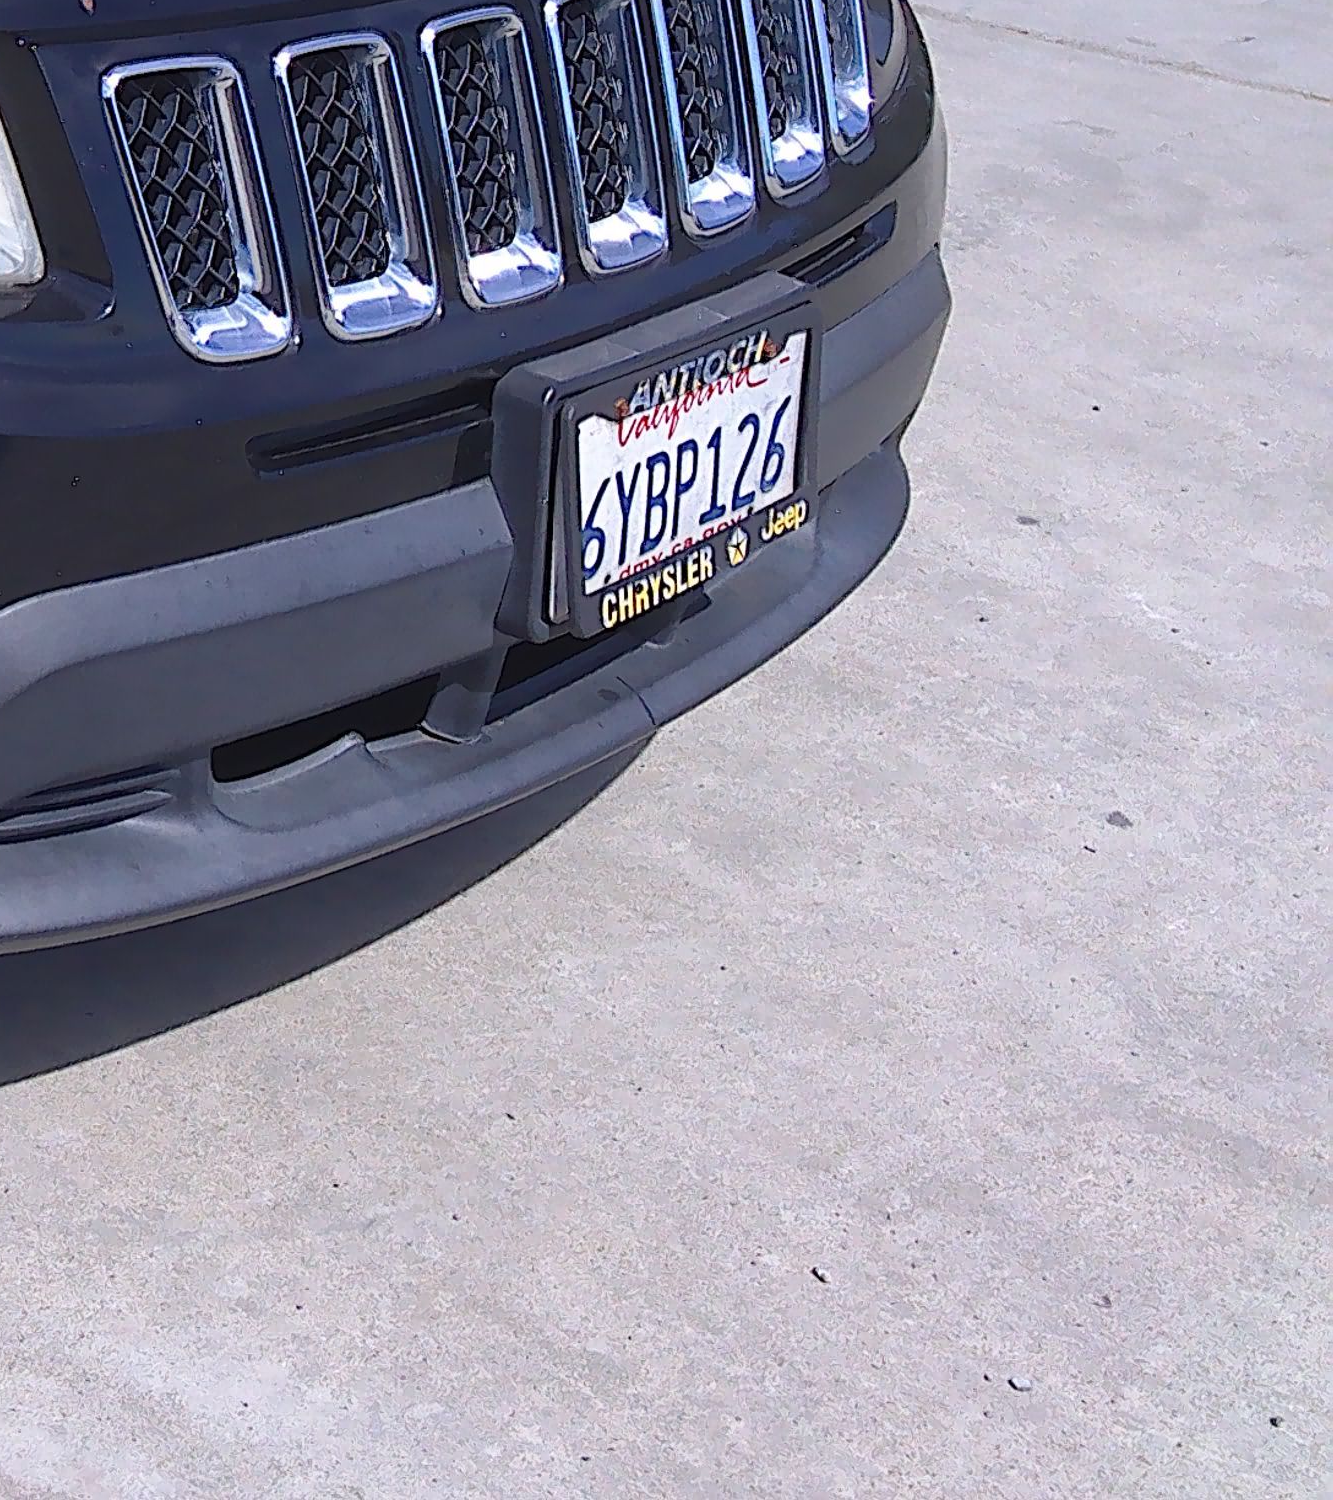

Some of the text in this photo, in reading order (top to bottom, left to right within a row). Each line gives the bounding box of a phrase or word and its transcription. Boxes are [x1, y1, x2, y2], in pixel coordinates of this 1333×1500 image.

[629, 330, 768, 417] ANTIOCH
[581, 394, 792, 579] 6YBP126
[601, 497, 810, 629] CHRYSLER Jeep
